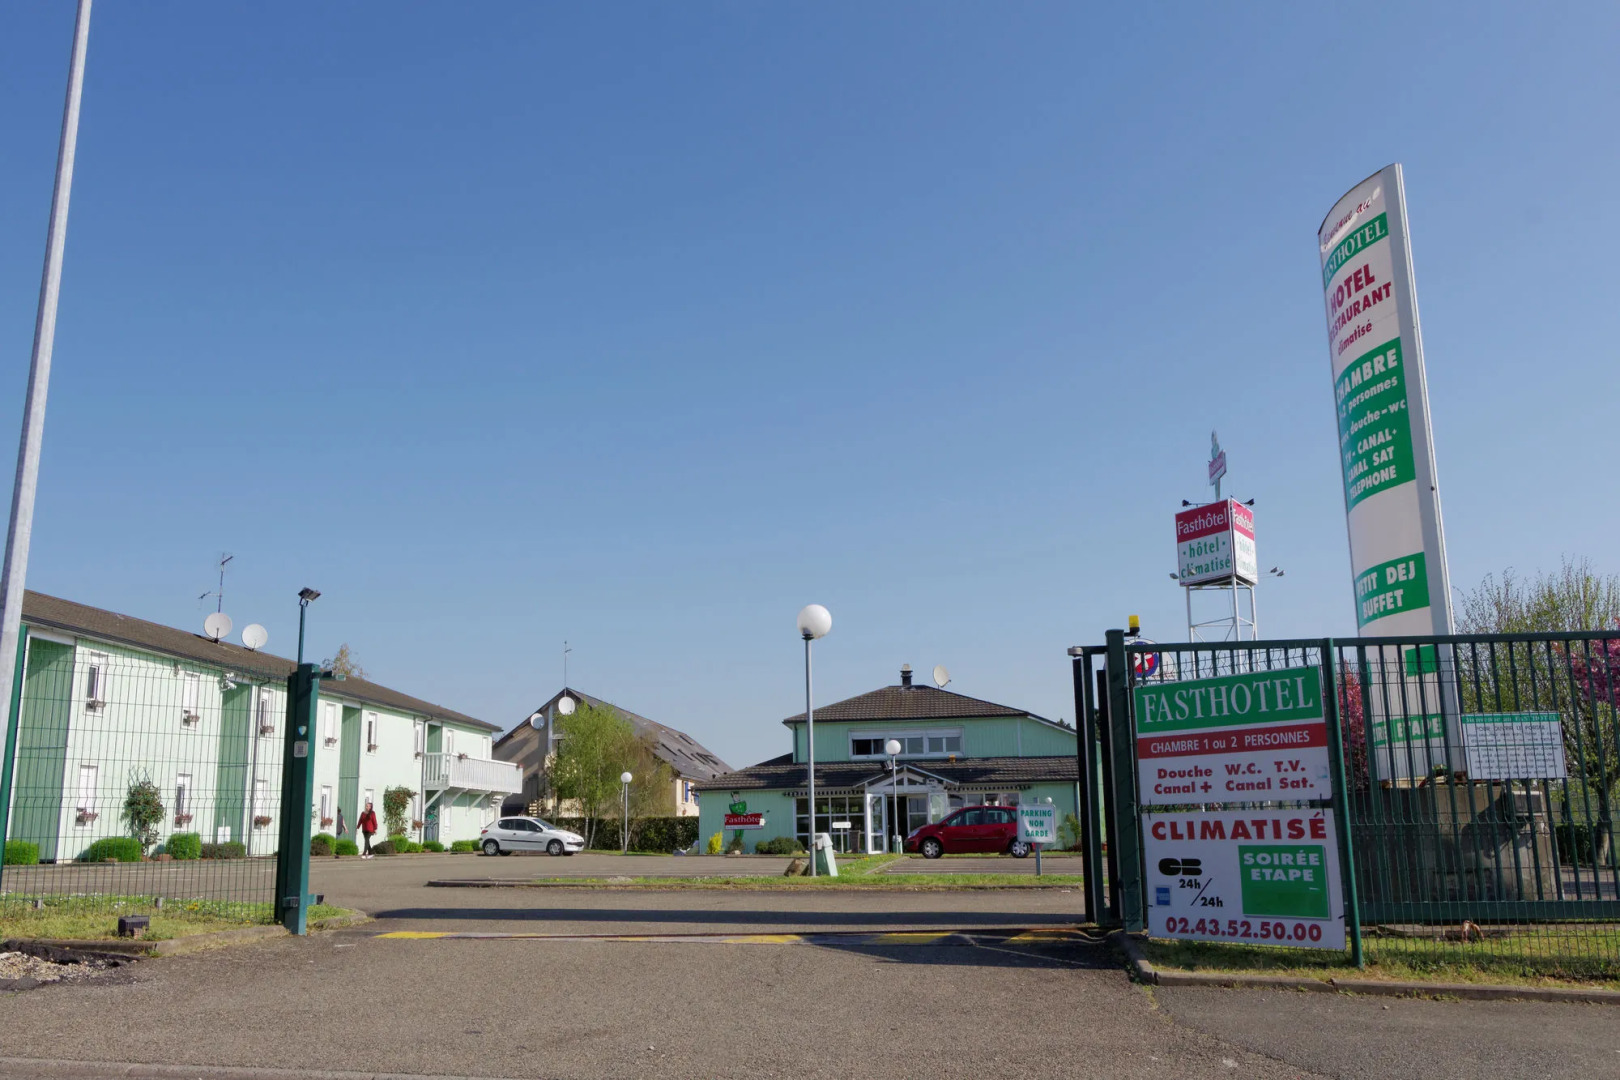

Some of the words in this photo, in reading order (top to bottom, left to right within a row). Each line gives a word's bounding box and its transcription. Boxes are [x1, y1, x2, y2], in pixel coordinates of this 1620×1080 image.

[1331, 263, 1375, 317] HOTEL
[1337, 348, 1398, 404] CHAMBRE
[1348, 376, 1398, 410] personnes
[1373, 446, 1395, 467] SAT
[1177, 507, 1228, 536] Fasthôtel
[1189, 536, 1220, 558] hôtel
[1386, 560, 1416, 586] DEJ
[1362, 589, 1404, 620] BUFFET
[1143, 677, 1313, 723] FASTHOTEL
[1151, 739, 1199, 753] CHAMBRE
[1203, 738, 1209, 750] 1
[1213, 740, 1226, 749] ou
[1231, 737, 1237, 748] 2
[1245, 731, 1310, 747] PERSONNES
[1157, 765, 1213, 779] Douche
[1225, 763, 1262, 775] W.C.
[1274, 760, 1306, 773] T.V.
[1154, 781, 1195, 795] Canal
[1200, 781, 1212, 793] +
[1225, 778, 1271, 792] Canal
[1279, 775, 1314, 789] Sat.
[725, 814, 762, 825] Fasthôte
[1020, 809, 1052, 817] PARKING
[1152, 811, 1327, 840] CLIMATISÉ
[1244, 849, 1319, 866] SOIRÉE
[1251, 868, 1314, 882] ETAPE
[1166, 916, 1321, 942] 02.43.52.50.00
